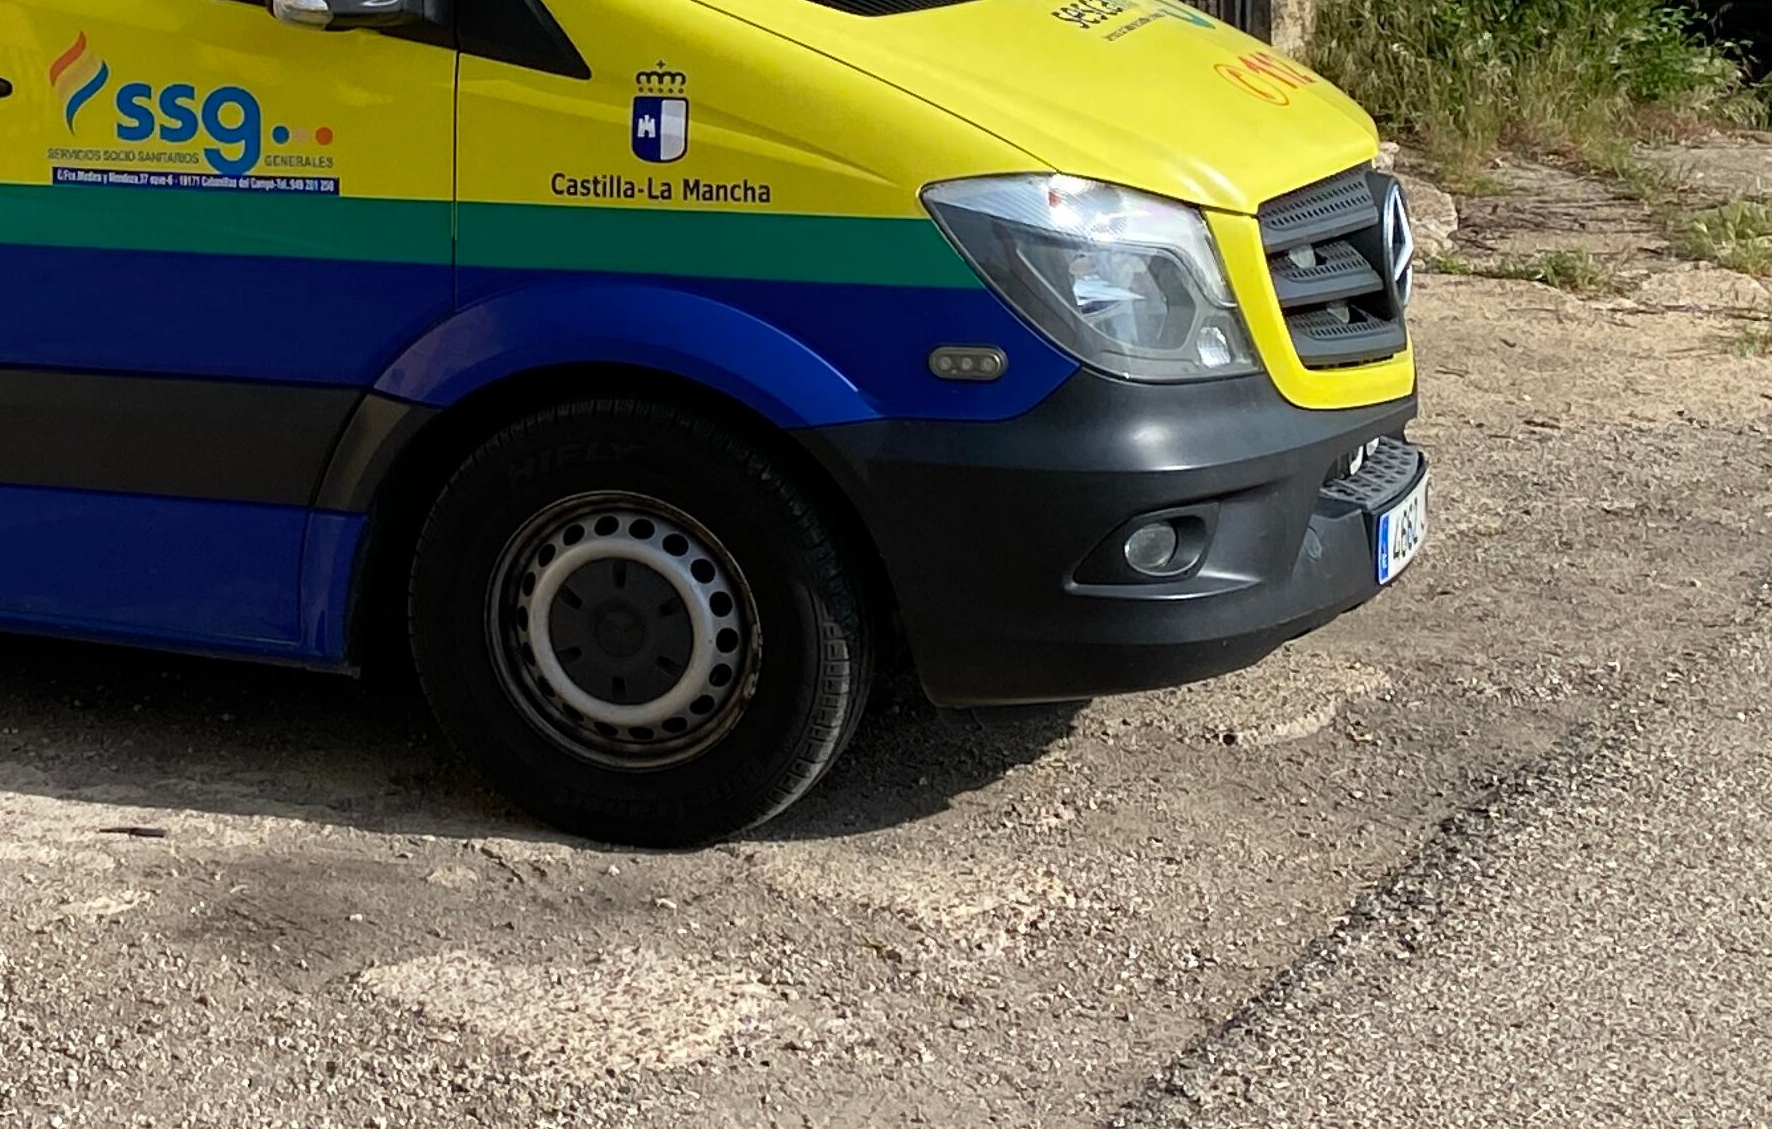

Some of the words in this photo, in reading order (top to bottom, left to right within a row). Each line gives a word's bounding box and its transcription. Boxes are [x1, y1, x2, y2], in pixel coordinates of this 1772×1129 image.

[47, 147, 102, 162] SERVICIOS
[102, 150, 136, 163] SOCIO
[136, 150, 200, 165] SANITARIOS
[264, 154, 334, 169] GENERALES
[550, 172, 673, 201] Castilla-La
[682, 177, 772, 204] Mancha
